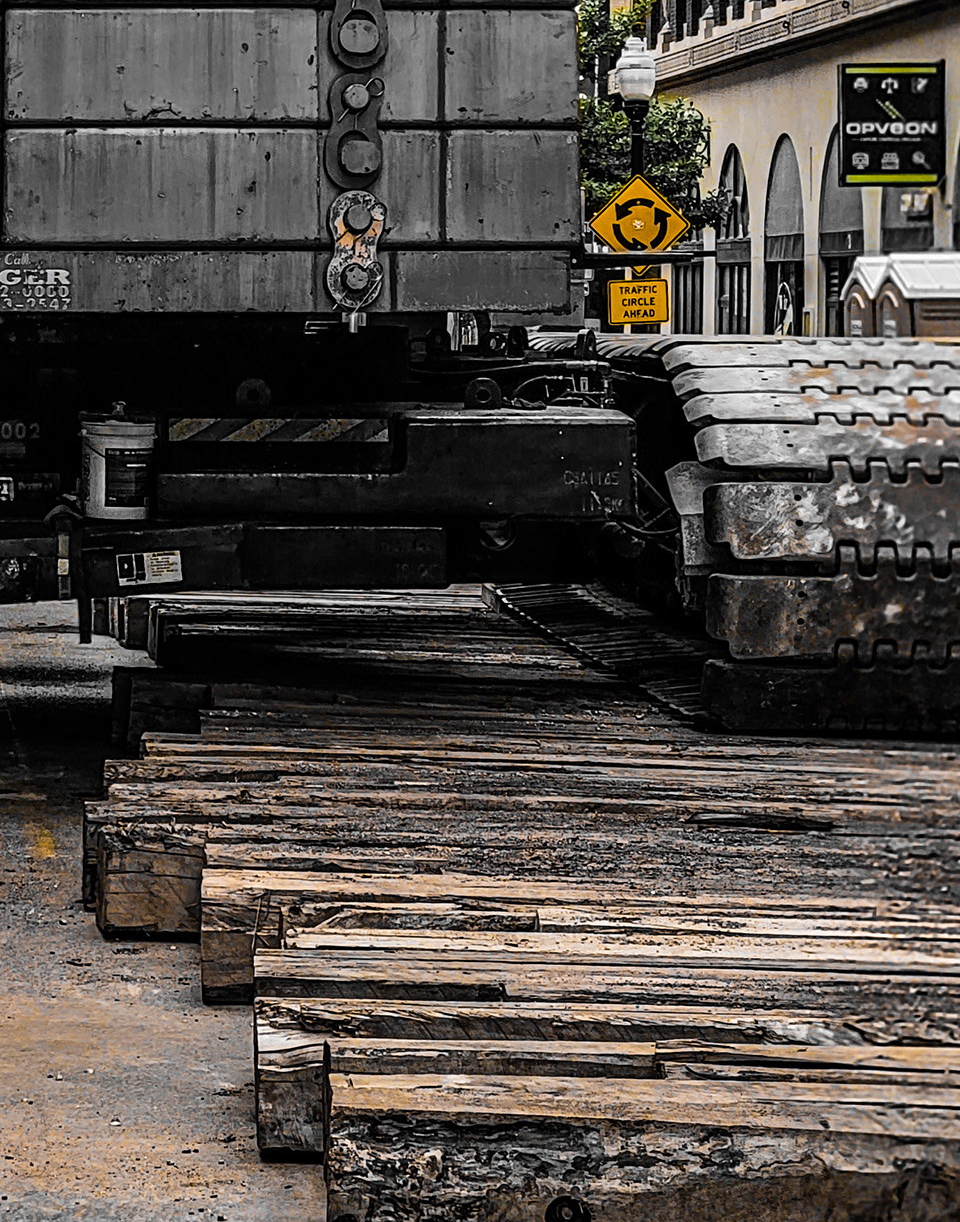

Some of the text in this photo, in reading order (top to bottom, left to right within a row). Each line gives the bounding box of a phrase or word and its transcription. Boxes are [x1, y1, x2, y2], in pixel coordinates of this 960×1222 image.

[619, 285, 658, 295] TRAFFIC
[622, 297, 656, 307] CIRCLE
[623, 309, 656, 319] AHEAD
